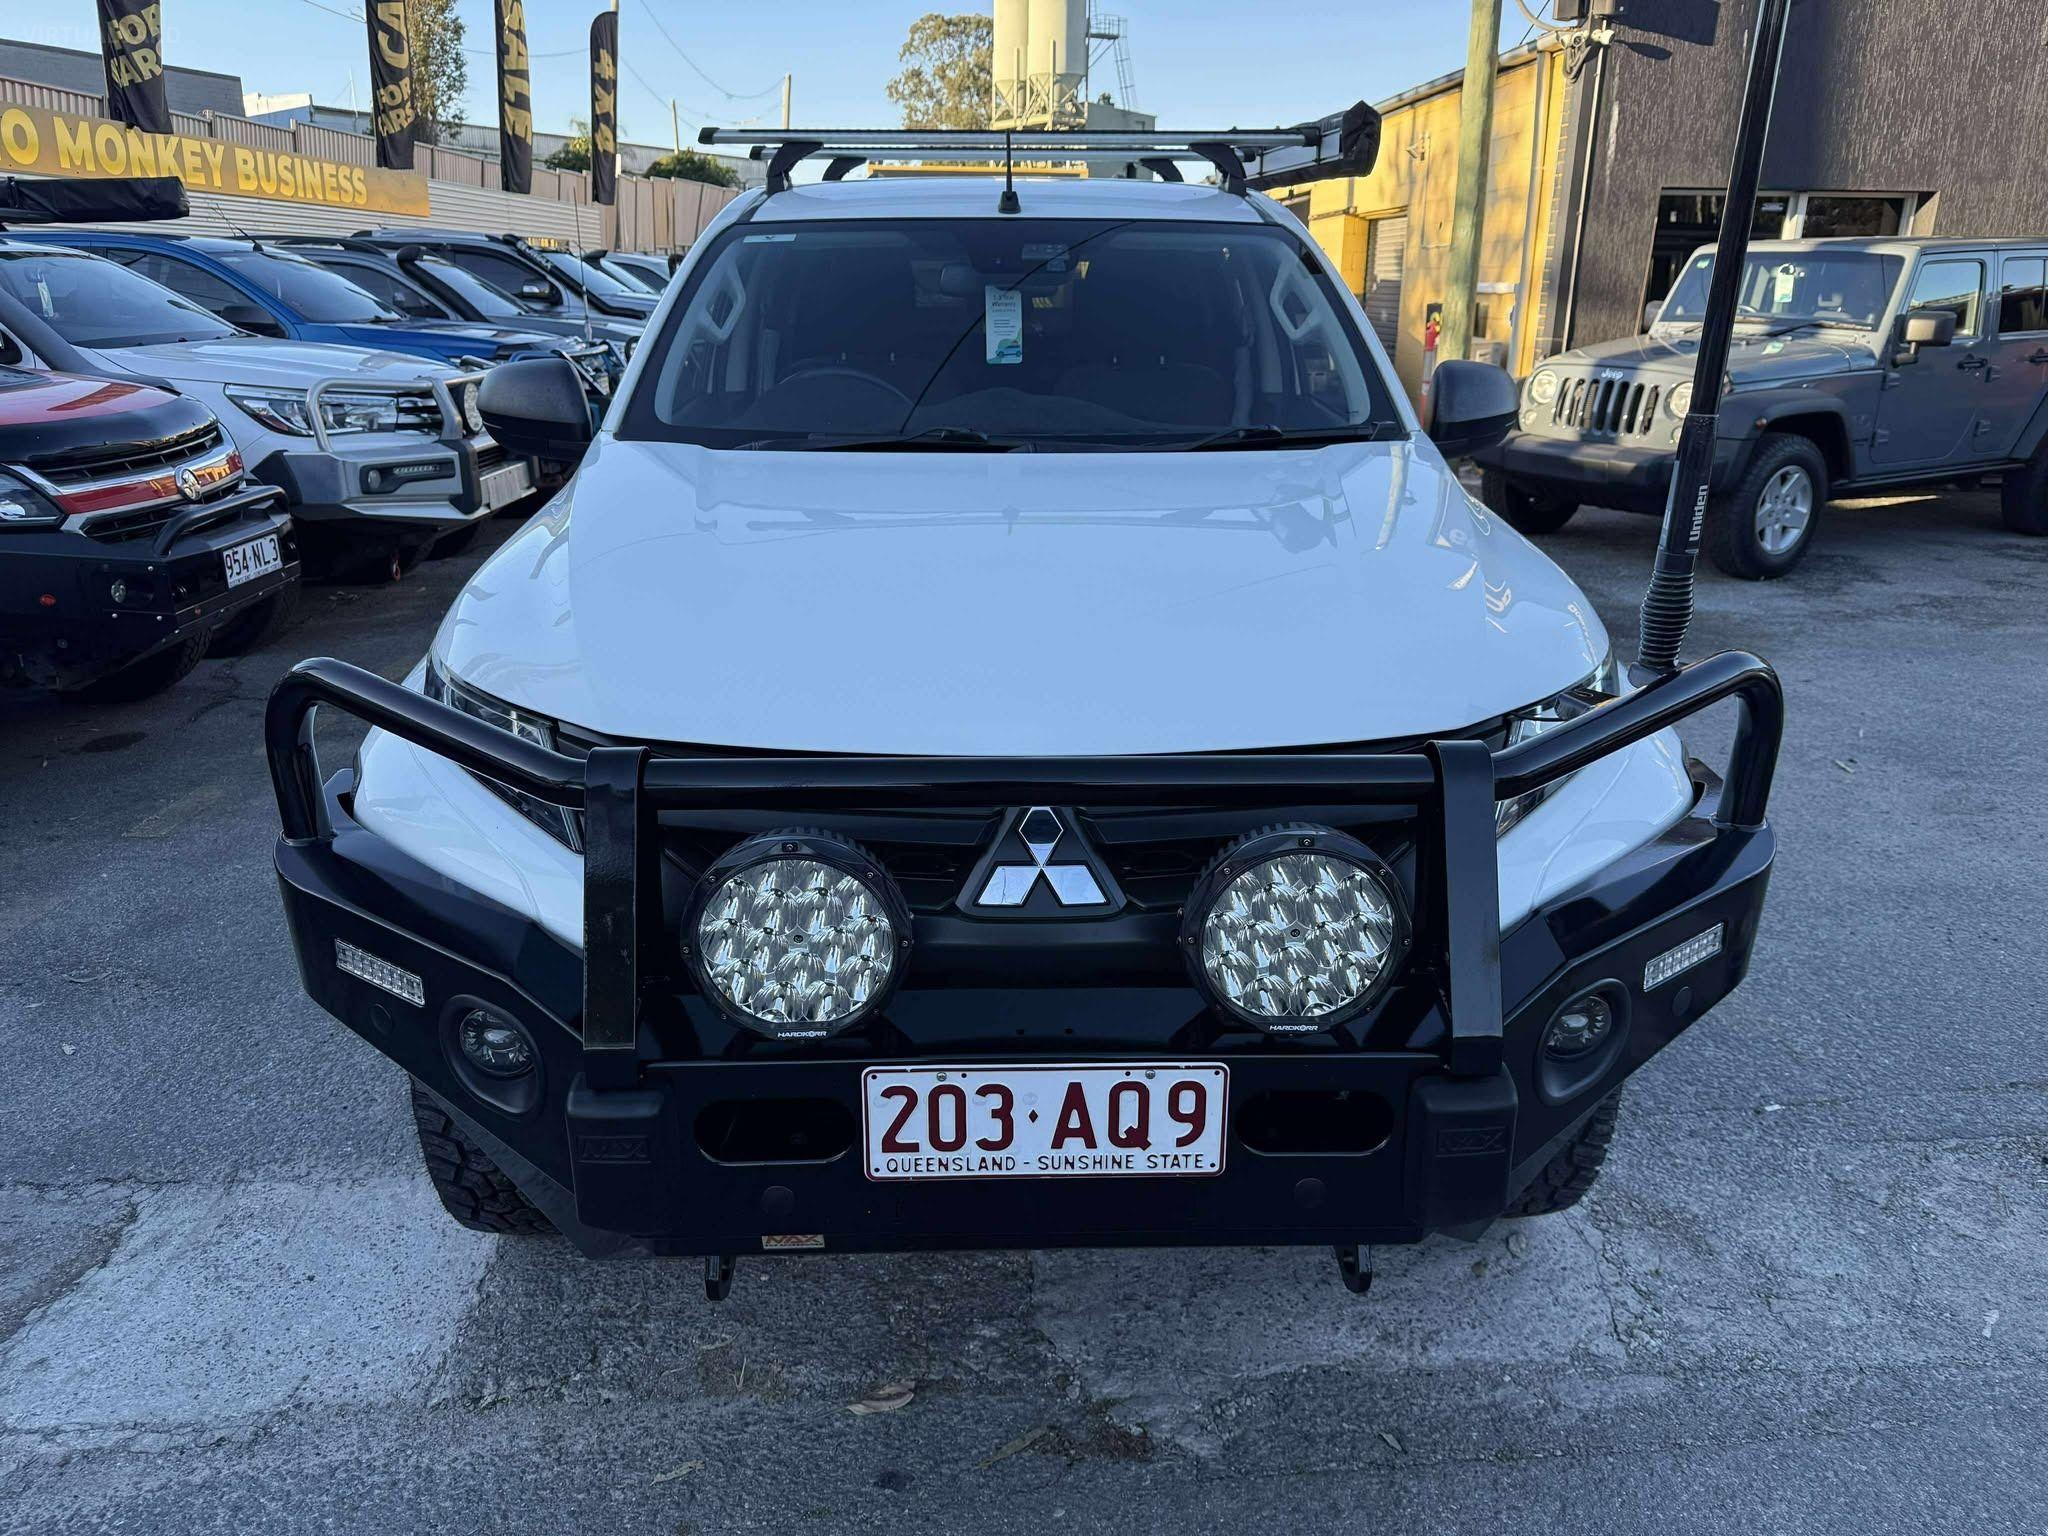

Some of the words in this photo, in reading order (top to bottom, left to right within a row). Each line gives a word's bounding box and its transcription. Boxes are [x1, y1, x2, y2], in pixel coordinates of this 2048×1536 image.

[500, 0, 532, 145] SALE
[53, 116, 225, 188] MONKEY
[234, 147, 368, 206] BUSINESS
[886, 1156, 1016, 1173] QUEENSLAND
[1037, 1154, 1135, 1170] SUNSHINE
[1146, 1153, 1204, 1169] STATE
